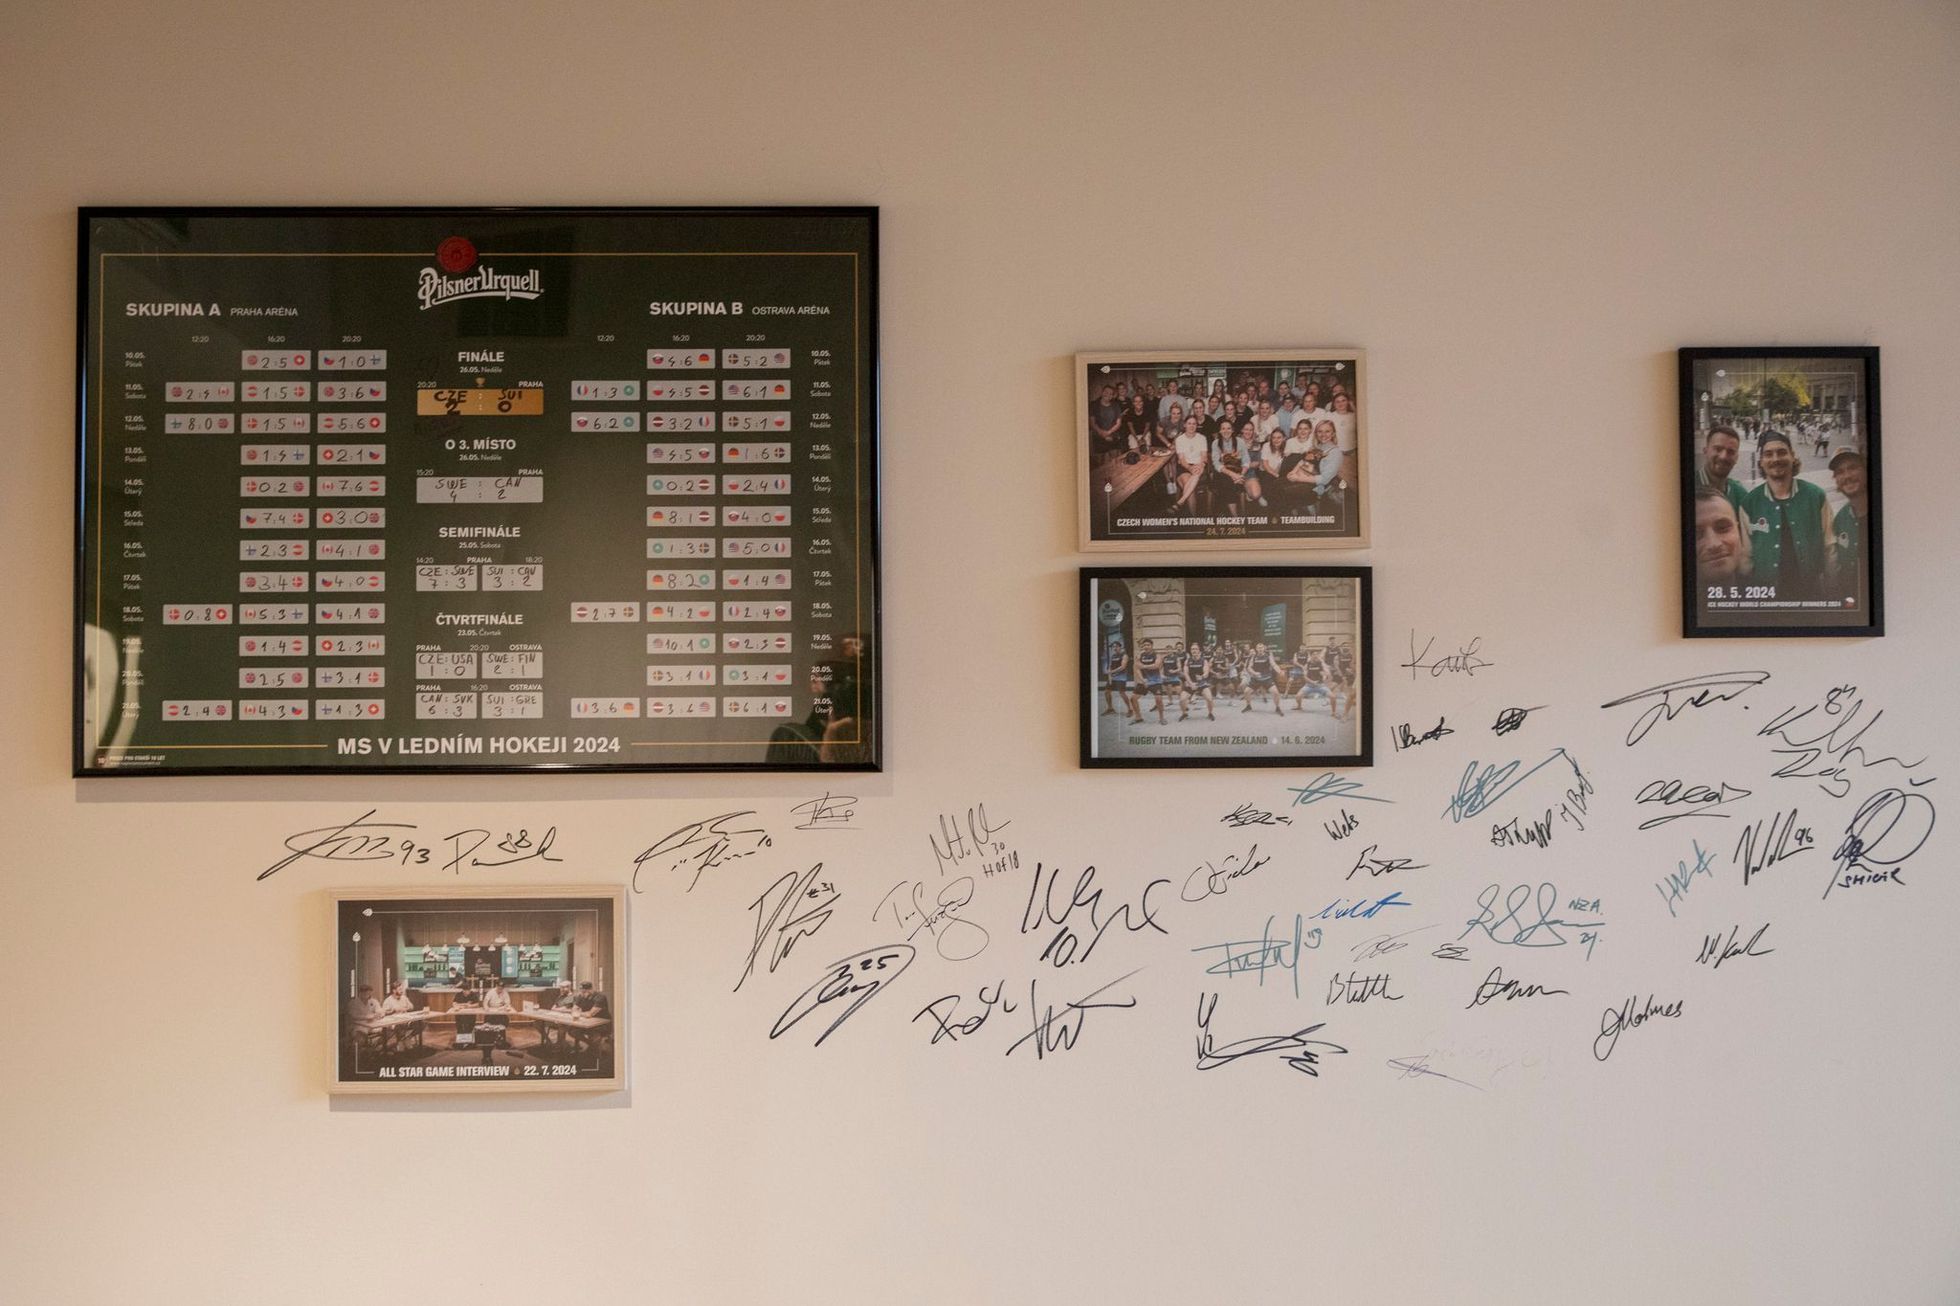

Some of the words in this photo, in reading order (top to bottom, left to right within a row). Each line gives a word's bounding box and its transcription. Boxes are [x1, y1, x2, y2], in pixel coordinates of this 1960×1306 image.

[417, 267, 482, 311] Pilsner
[478, 265, 540, 301] Urquell
[126, 303, 204, 317] SKUPINA
[208, 303, 221, 317] A
[230, 307, 263, 317] PRAHA
[265, 305, 299, 317] ARÉNA
[650, 302, 728, 316] SKUPINA
[731, 302, 744, 316] B
[752, 306, 795, 316] OSTRAVA
[797, 304, 831, 316] ARÉNA
[458, 350, 505, 363] FINÁLE
[434, 390, 468, 403] CZE
[445, 439, 456, 451] O
[459, 439, 470, 451] 3.
[473, 437, 517, 450] MÍSTO
[1117, 518, 1141, 527] CZECH
[1179, 517, 1216, 526] NATIONAL
[1216, 517, 1246, 526] HOCKEY
[1247, 516, 1268, 525] TEAM
[1280, 515, 1335, 525] TEAMBUILDING
[439, 525, 521, 538] SEMIFINÁLE
[1707, 586, 1727, 599] 28.
[1730, 586, 1742, 599] 5.
[1745, 586, 1777, 599] 2024
[436, 612, 524, 626] ČTVRTFINÁLE
[338, 738, 372, 755] MS
[377, 738, 393, 754] V
[399, 734, 483, 754] LEDNÍM
[490, 737, 567, 754] HOKEJI
[573, 737, 621, 753] 2024
[1129, 736, 1157, 745] RUGBY
[1159, 736, 1183, 745] TEAM
[1184, 736, 1208, 745] FROM
[1210, 736, 1230, 745] NEW
[1231, 736, 1268, 745] ZEALAND
[1305, 736, 1326, 745] 2024
[379, 1067, 397, 1078] ALL
[398, 1067, 423, 1078] STAR
[425, 1066, 455, 1077] GAME
[456, 1066, 510, 1077] INTERVIEW
[523, 1065, 540, 1076] 22.
[541, 1065, 550, 1076] 7.
[552, 1065, 578, 1076] 2024
